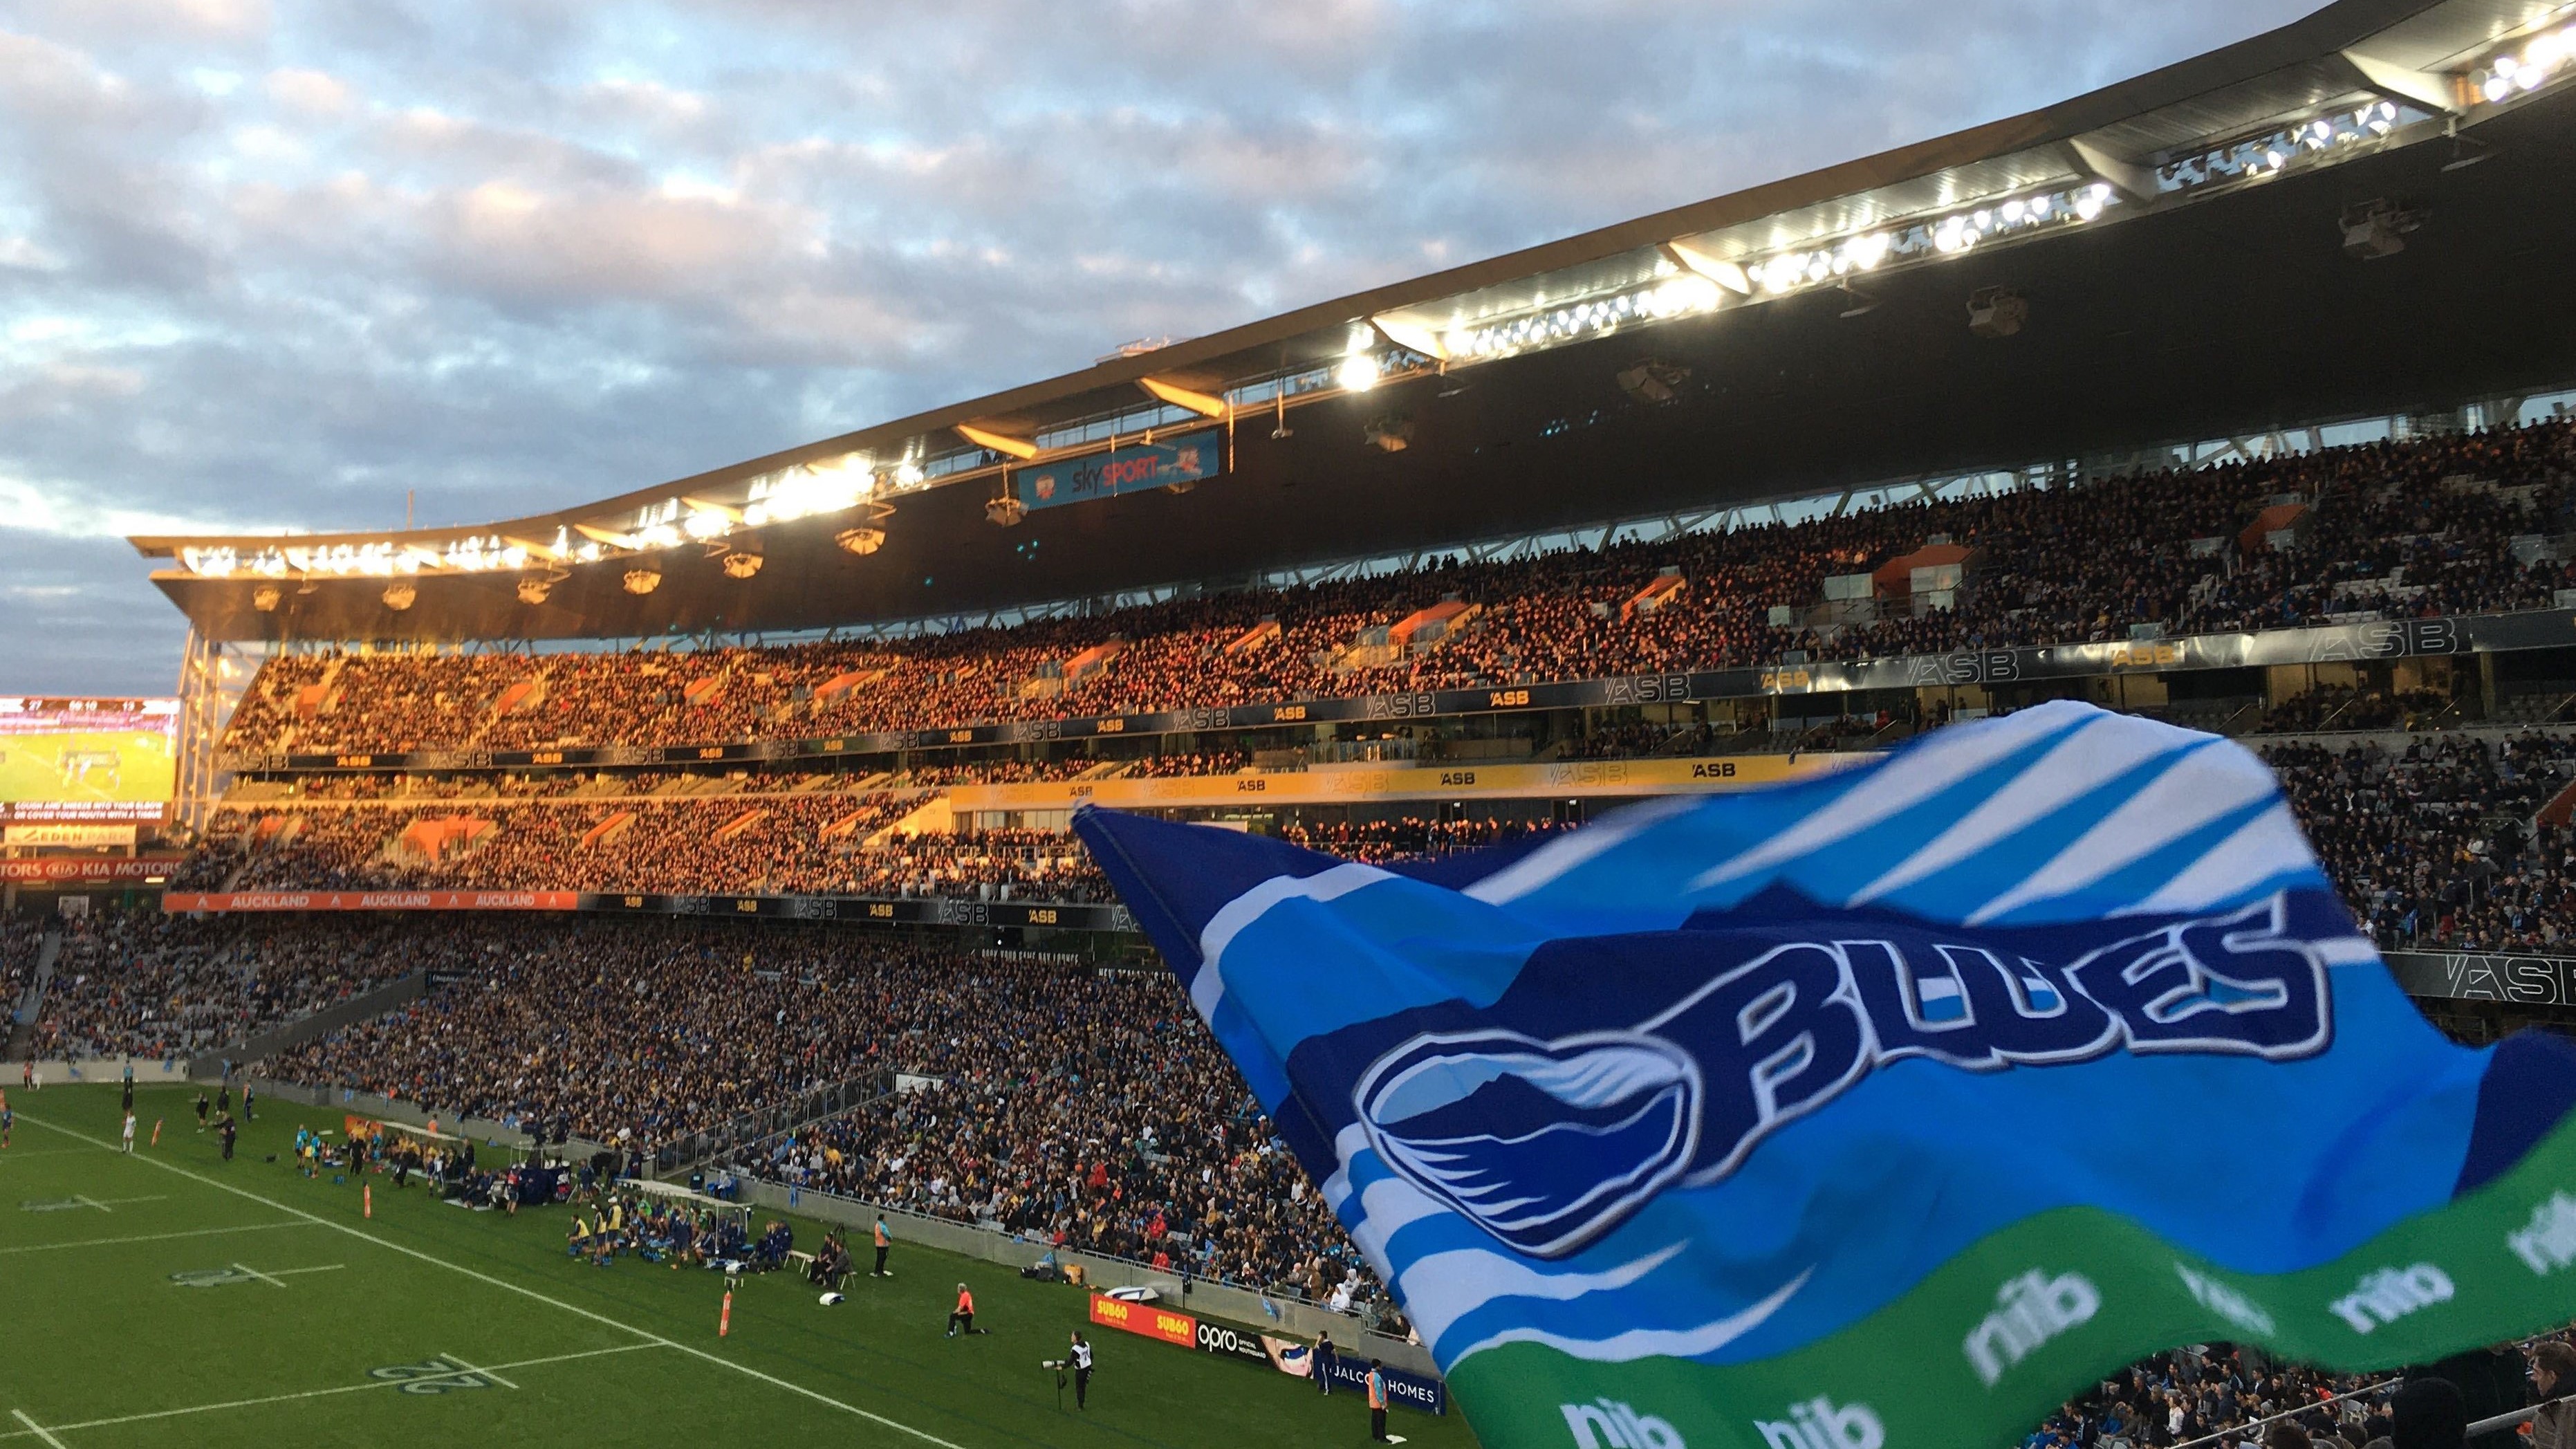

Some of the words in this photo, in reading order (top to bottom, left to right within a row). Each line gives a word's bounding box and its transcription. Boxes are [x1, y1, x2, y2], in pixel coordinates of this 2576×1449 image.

[1073, 462, 1102, 493] sky
[1103, 455, 1158, 486] SPORT
[2308, 618, 2459, 662] ASB
[2111, 645, 2175, 667] ASB
[1907, 649, 2020, 685] ASB
[1604, 674, 1692, 705] ASB
[1366, 692, 1436, 719] ASB
[1490, 691, 1530, 707] ASB
[1173, 707, 1231, 732] ASB
[1274, 705, 1306, 721] ASB
[1013, 721, 1062, 742] ASB
[1097, 719, 1124, 733] ASB
[949, 731, 972, 743] ASB
[1693, 763, 1736, 777] ASB
[1237, 780, 1266, 792] ASB
[1440, 772, 1476, 786] ASB
[1069, 786, 1093, 797] ASB
[41, 831, 82, 842] EDEN
[82, 862, 110, 876] KIA
[231, 895, 310, 907] AUCKLAND
[361, 894, 430, 907] AUCKLAND
[475, 894, 535, 907] AUCKLAND
[737, 900, 757, 912] ASB
[869, 903, 894, 917] ASB
[1028, 910, 1057, 924] ASB
[1654, 889, 2337, 1187] BLUES
[1097, 1300, 1128, 1320] SUB60
[1157, 1315, 1189, 1336] SUB60
[1961, 1266, 2104, 1392] nib
[1198, 1324, 1238, 1353] opro
[1388, 1379, 1435, 1403] HOMES
